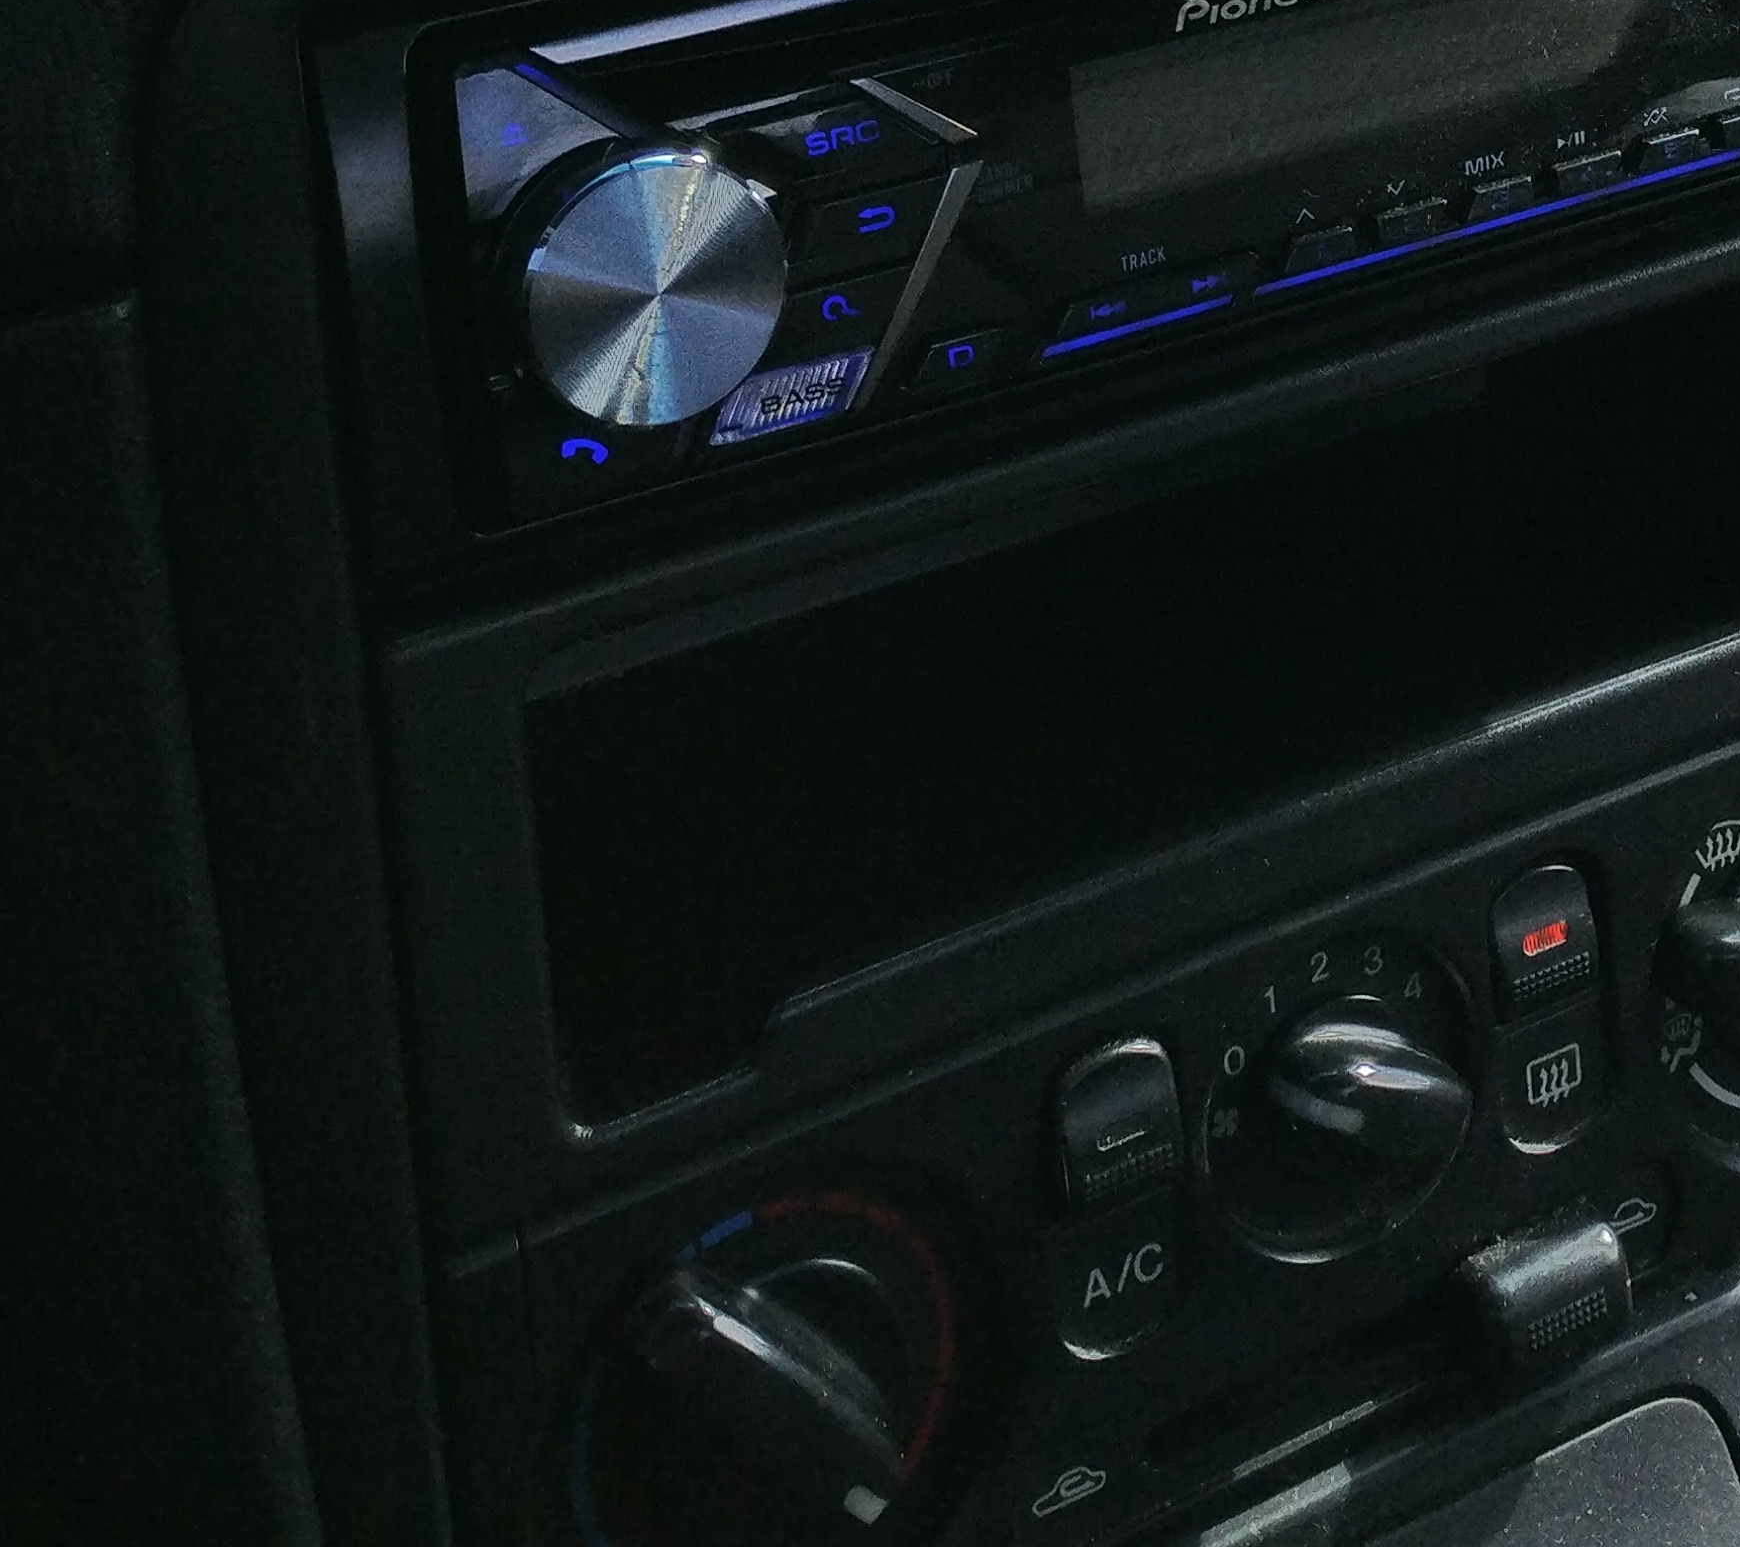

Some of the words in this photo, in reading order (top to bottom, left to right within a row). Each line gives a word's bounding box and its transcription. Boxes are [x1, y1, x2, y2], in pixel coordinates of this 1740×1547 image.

[804, 119, 881, 156] SRC
[1463, 149, 1506, 177] MIX
[1120, 246, 1167, 272] TRACK
[760, 376, 846, 415] BASS
[1310, 950, 1331, 984] 2
[1363, 946, 1384, 977] 3
[1263, 985, 1277, 1014] 1
[1403, 971, 1421, 999] 4
[1223, 1045, 1245, 1076] 0
[1083, 1243, 1164, 1309] A/C
